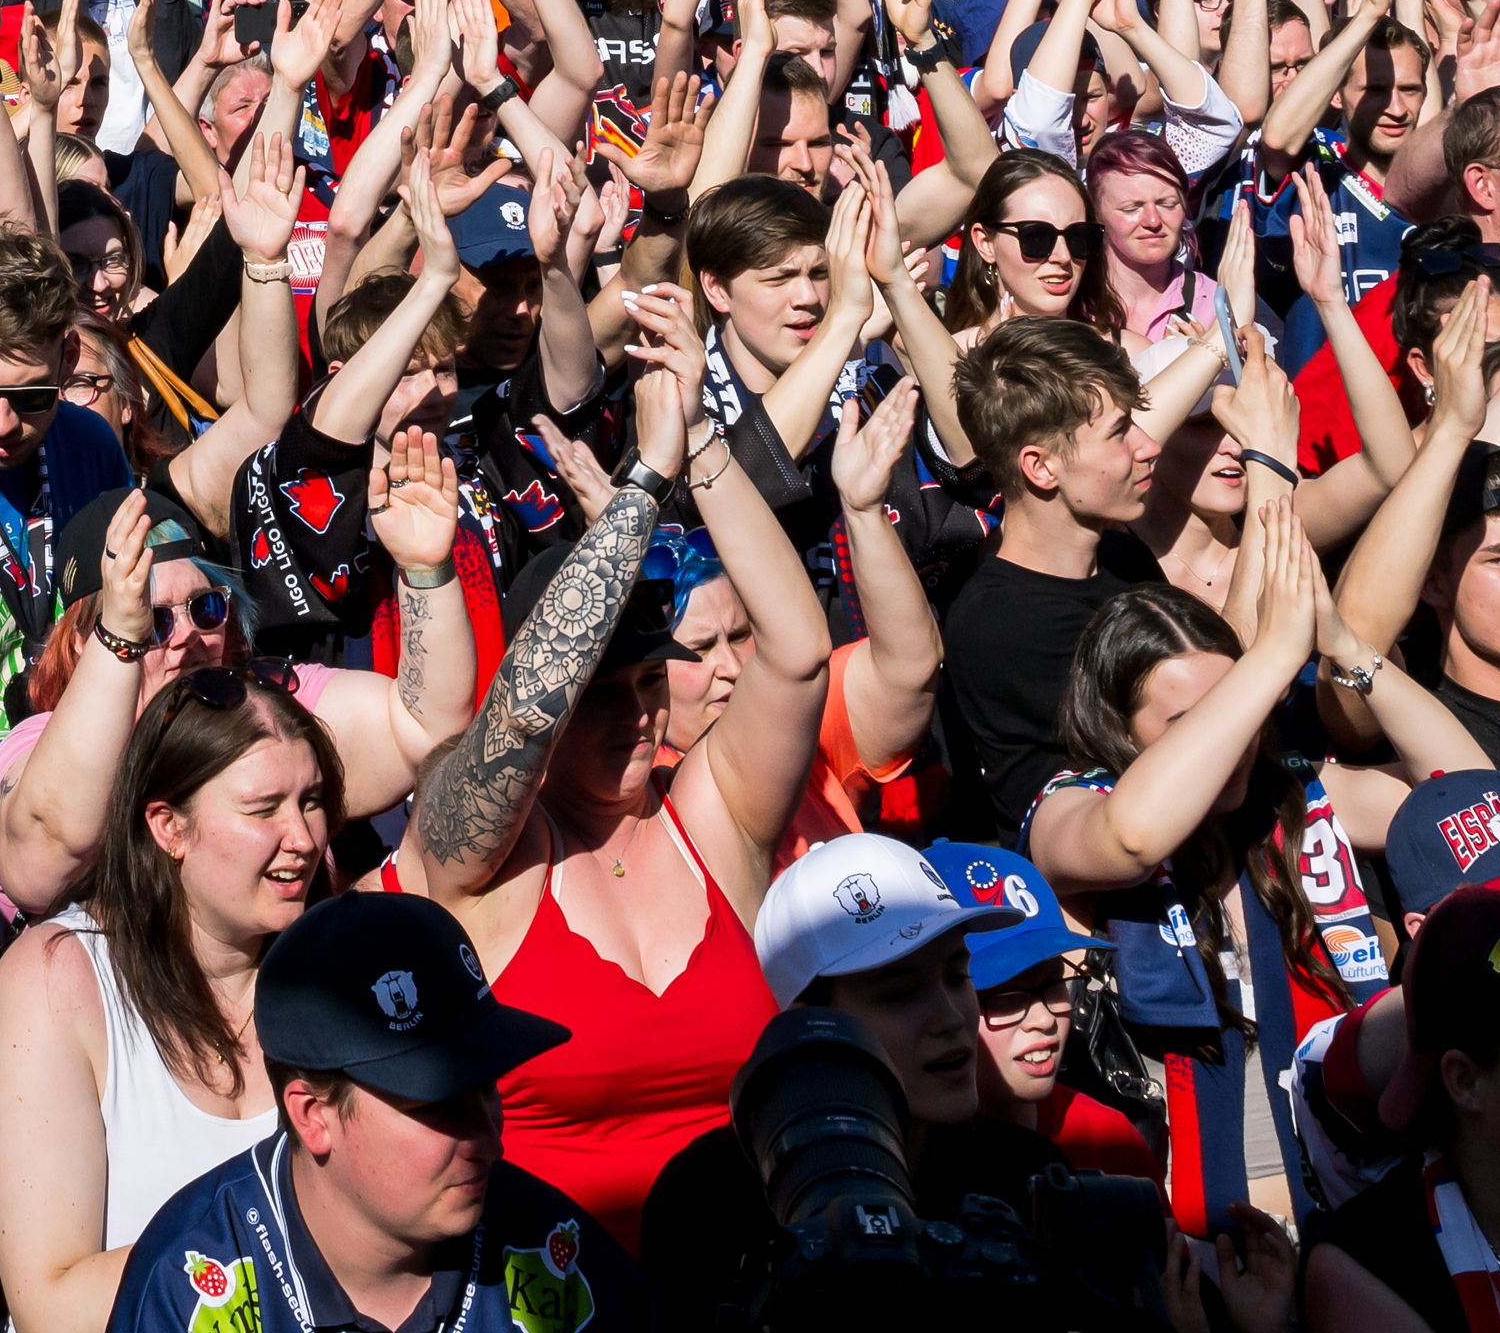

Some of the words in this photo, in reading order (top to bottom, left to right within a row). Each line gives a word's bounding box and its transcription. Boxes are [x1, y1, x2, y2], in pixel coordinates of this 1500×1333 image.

[268, 527, 293, 573] LIGO
[286, 571, 310, 617] LIGO
[388, 1010, 424, 1032] BERLIN
